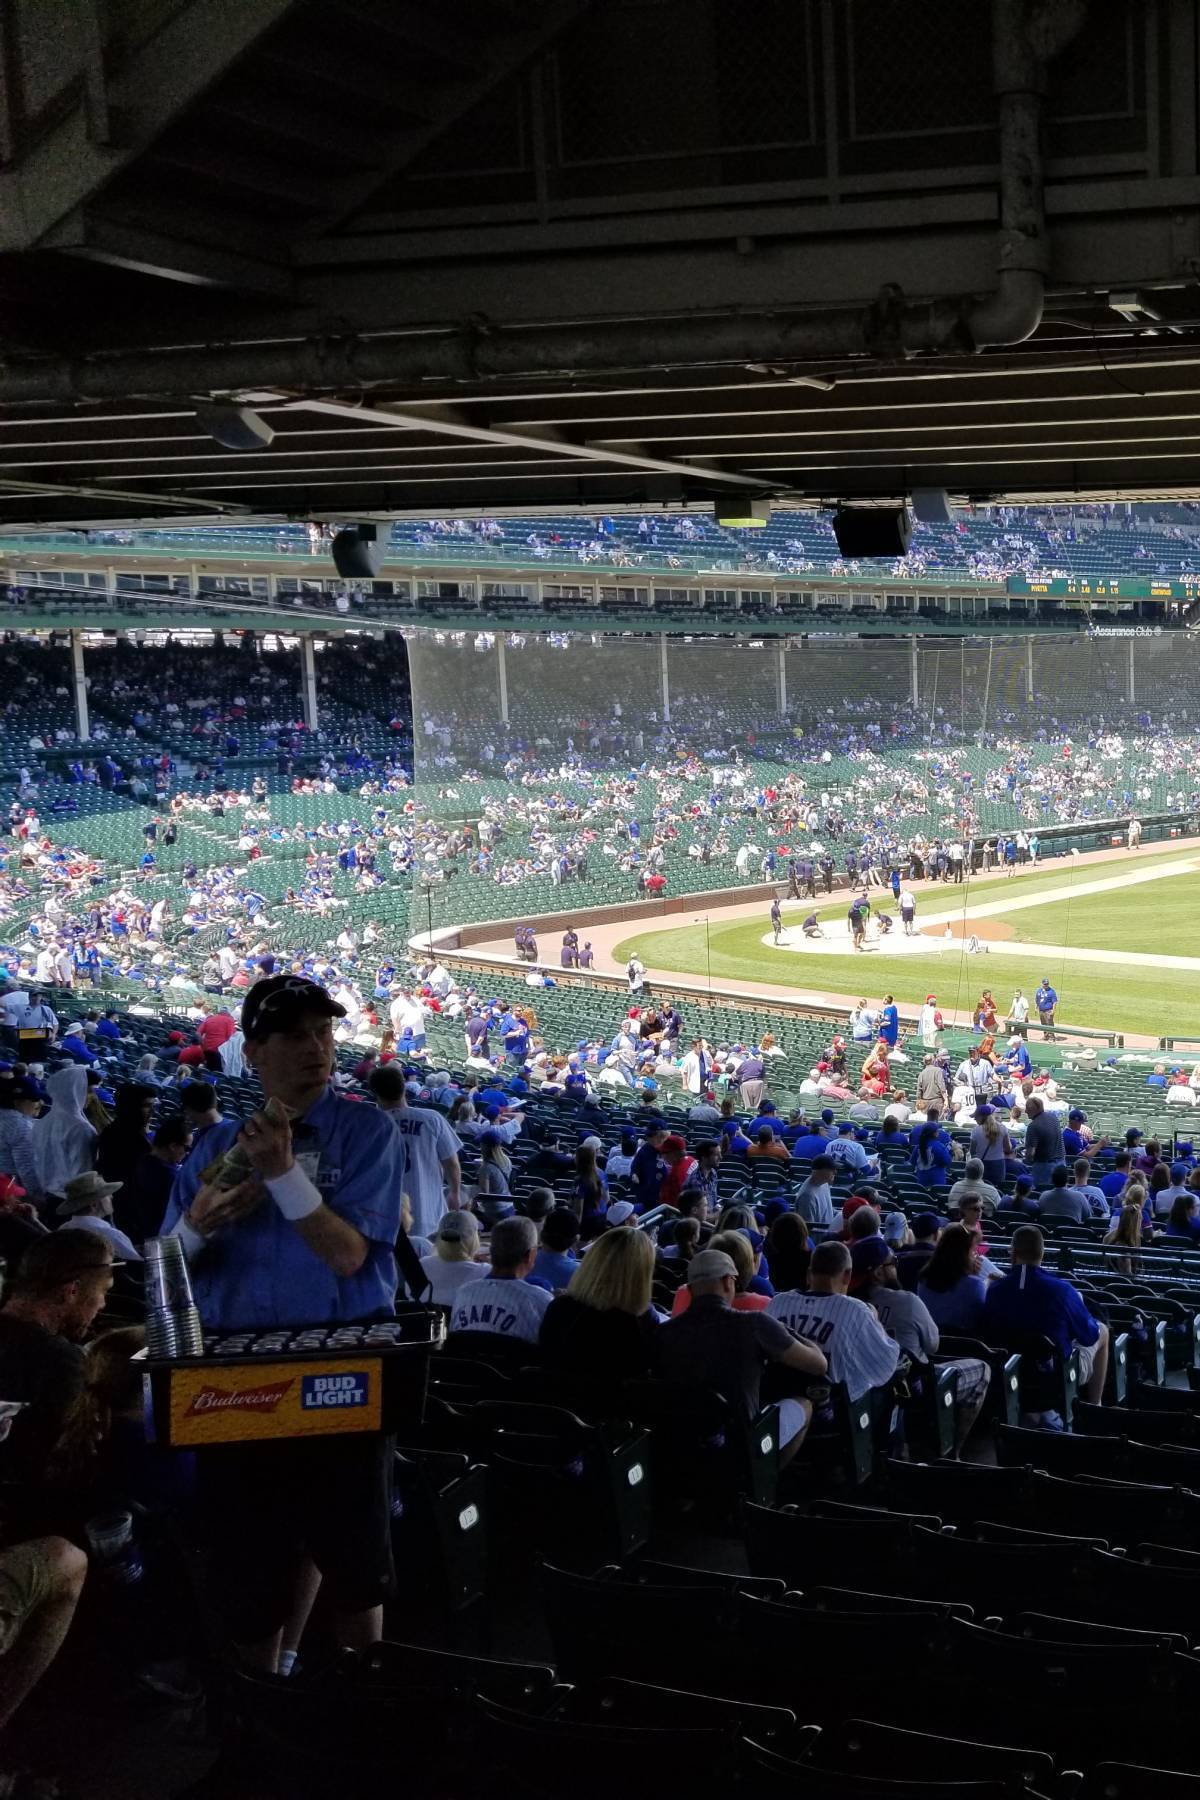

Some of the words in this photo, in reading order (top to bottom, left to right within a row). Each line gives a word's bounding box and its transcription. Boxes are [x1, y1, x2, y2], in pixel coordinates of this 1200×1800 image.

[1094, 625, 1135, 637] Assurance
[1136, 626, 1153, 637] Club
[965, 1094, 975, 1106] 10
[459, 1304, 517, 1332] SANTO
[313, 1376, 357, 1391] BUD
[194, 1390, 283, 1410] Budweiser
[305, 1389, 364, 1407] LIGHT
[463, 1509, 475, 1525] 12
